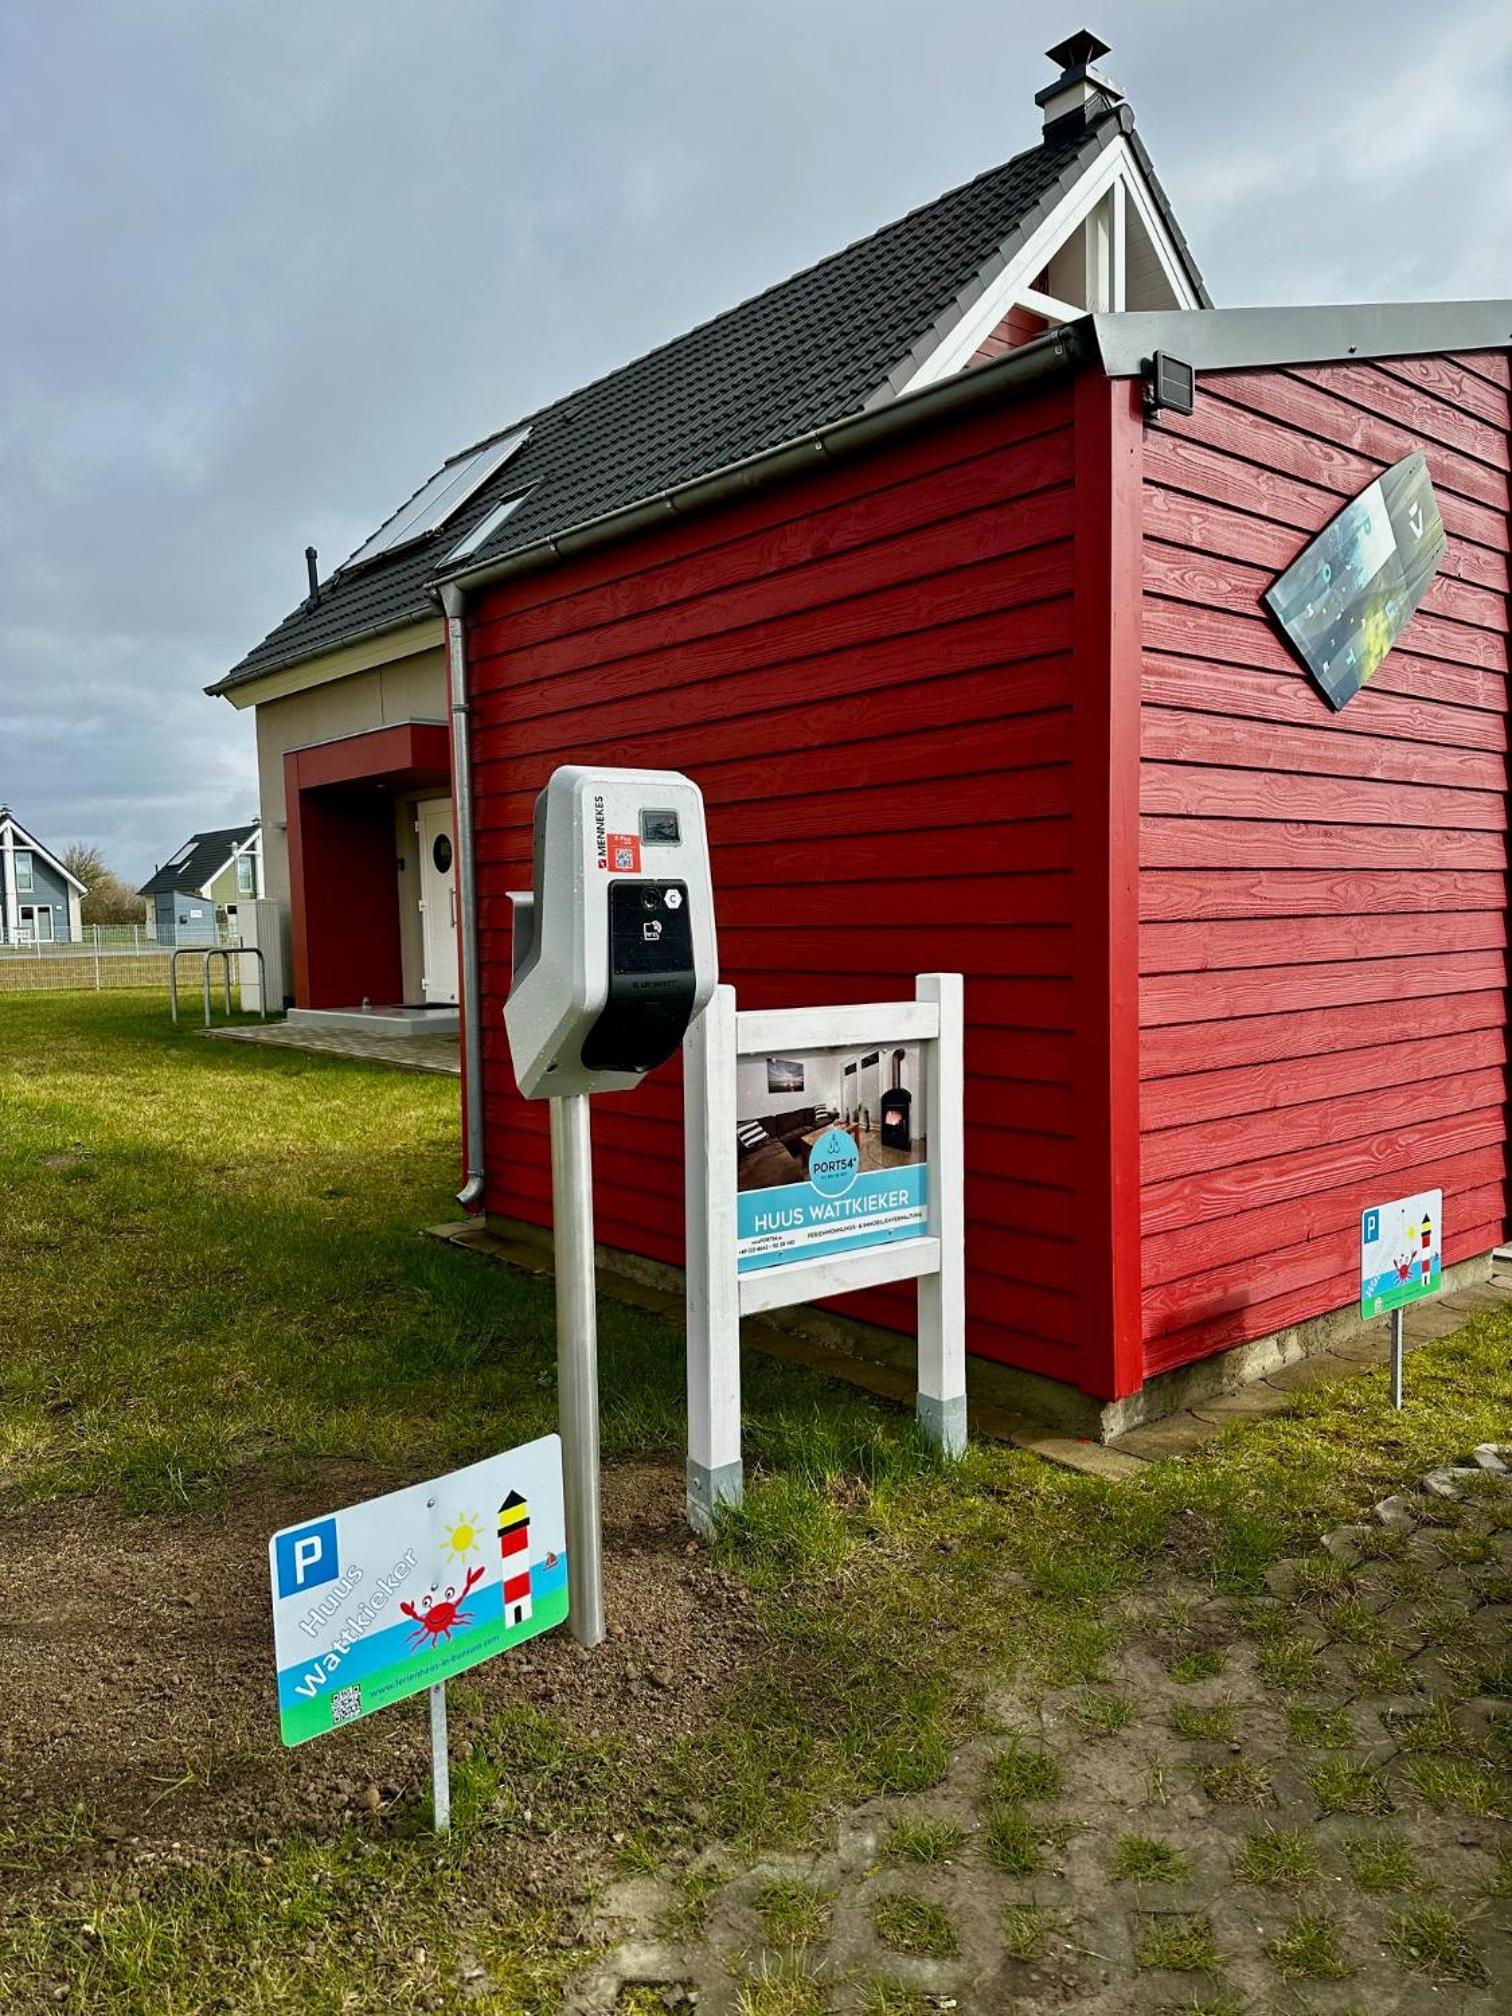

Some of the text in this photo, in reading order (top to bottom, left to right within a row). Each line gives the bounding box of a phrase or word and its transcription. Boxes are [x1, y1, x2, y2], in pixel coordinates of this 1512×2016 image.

[594, 795, 606, 857] MENNEKES
[669, 894, 677, 904] C
[754, 1189, 909, 1233] HUUS WATTKIEKER
[1367, 1215, 1376, 1240] P
[294, 1535, 323, 1585] P
[294, 1547, 418, 1698] Wattkieker
[300, 1564, 364, 1639] Huus
